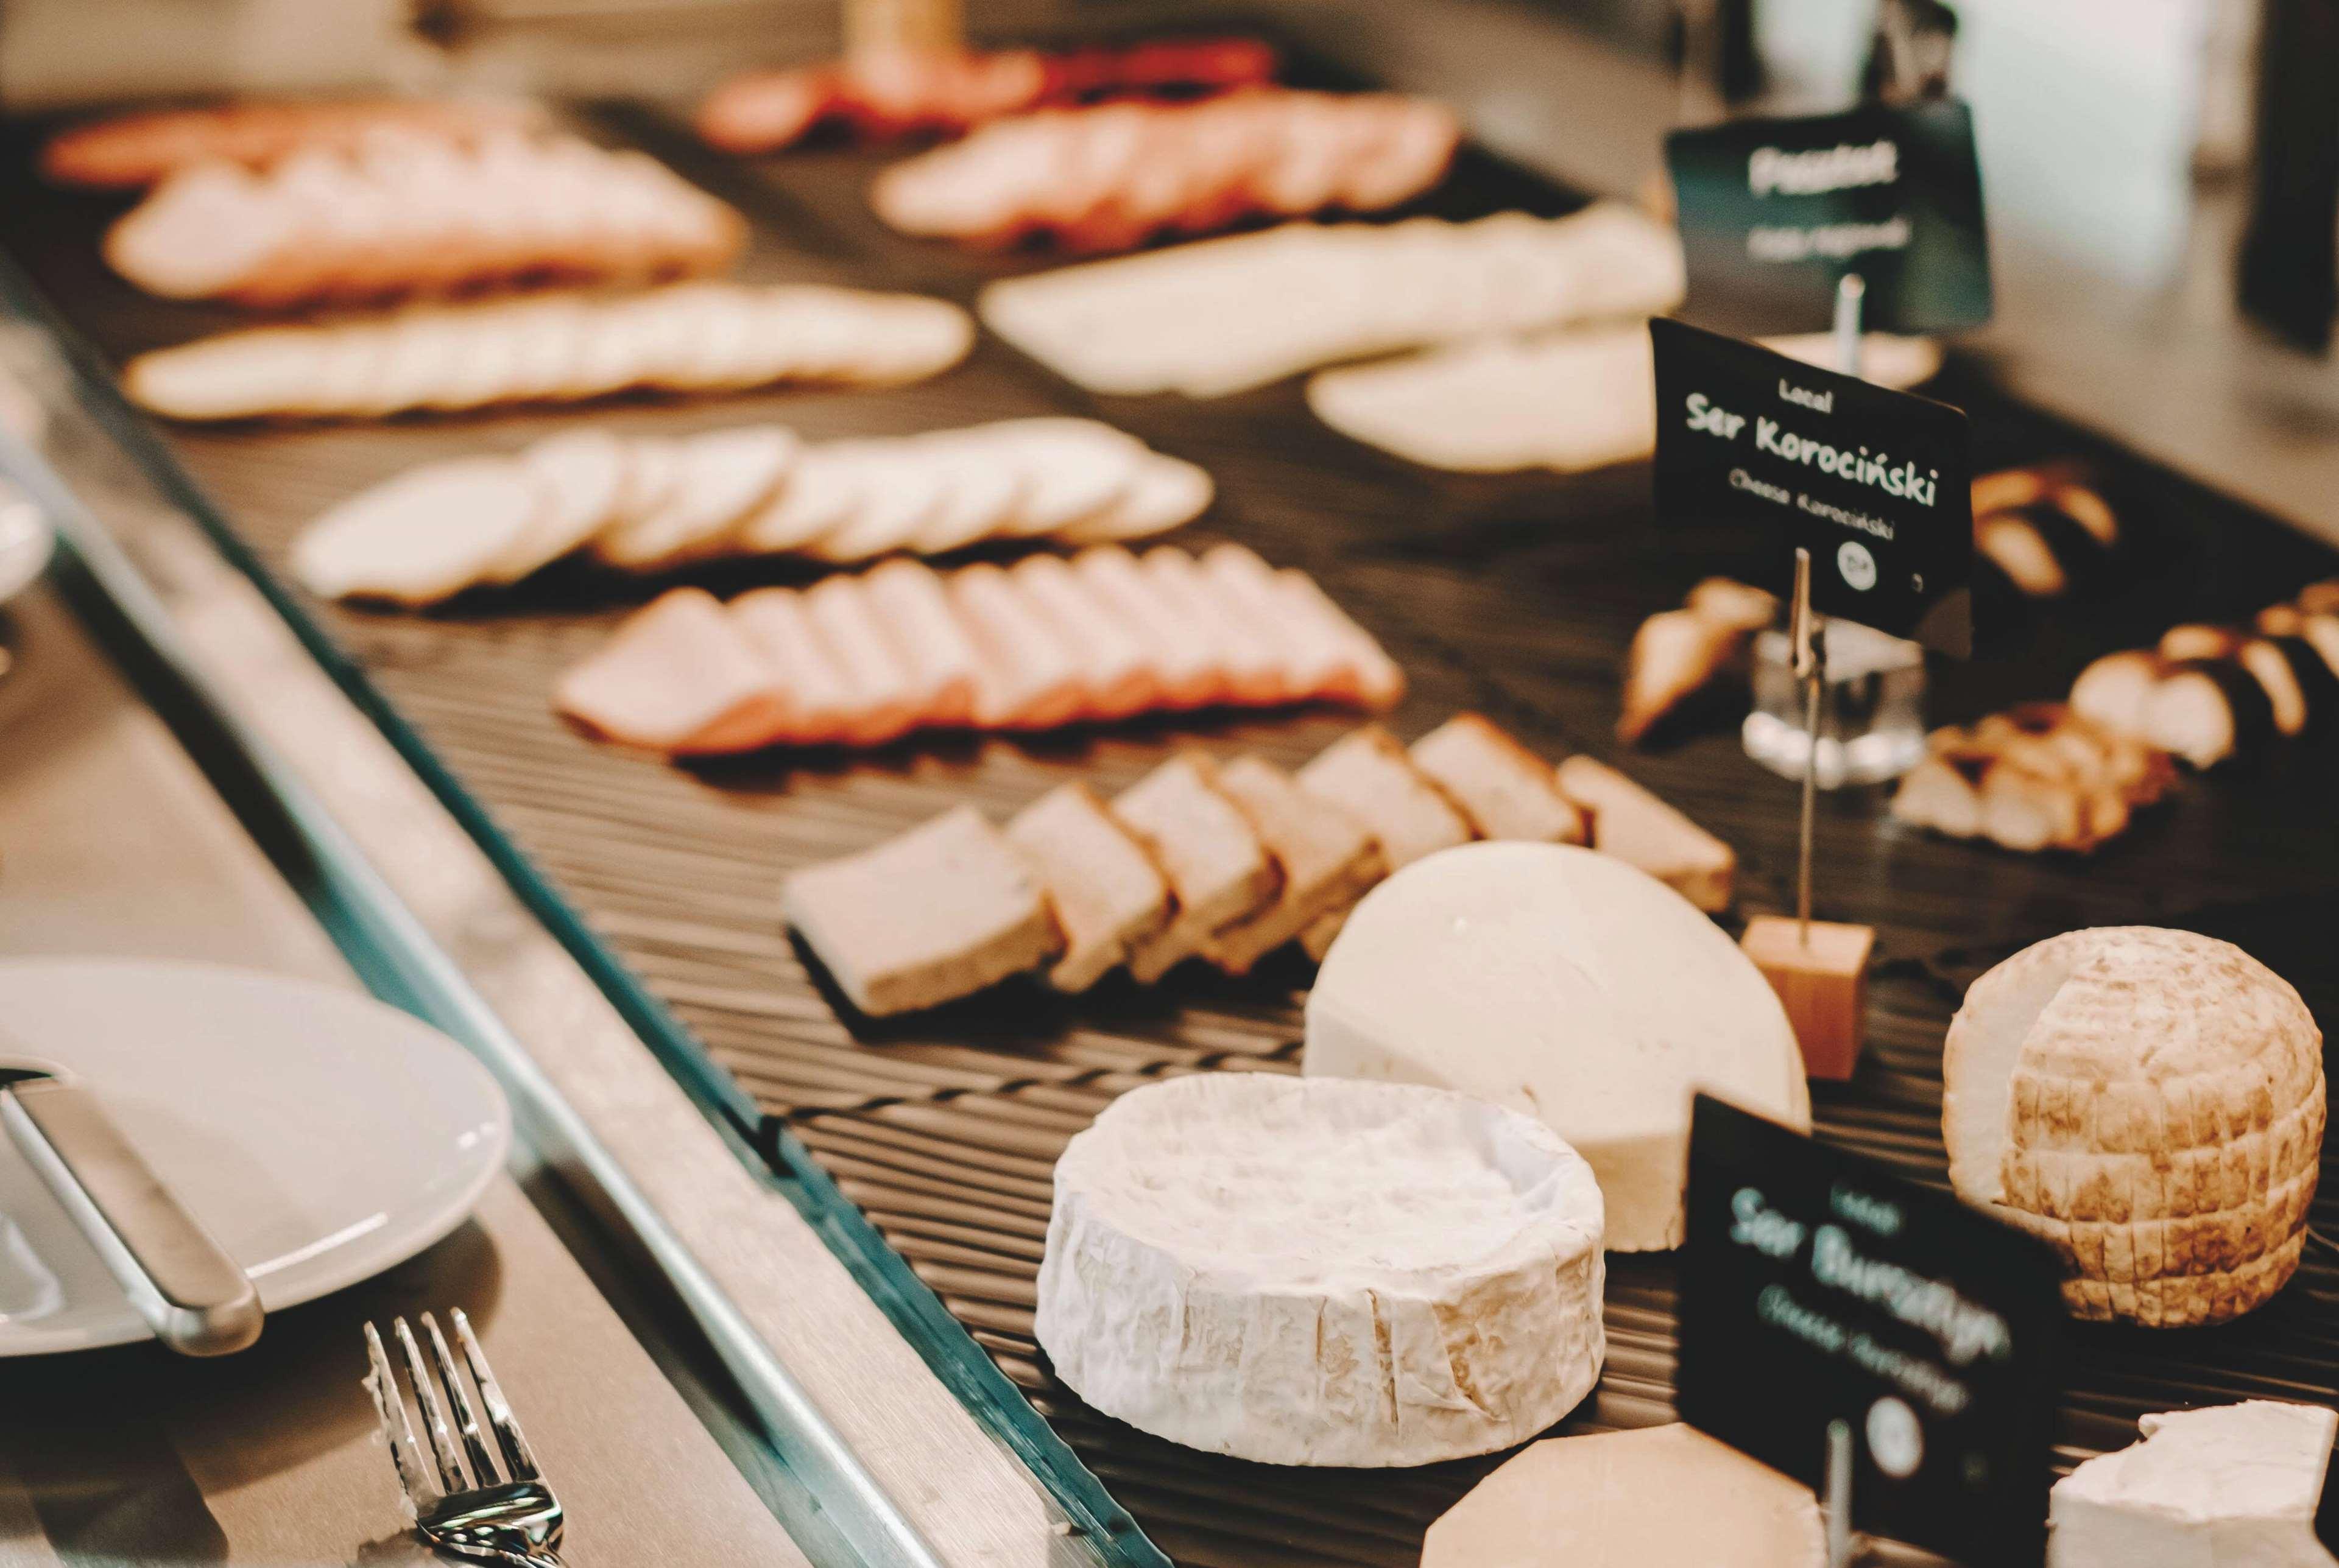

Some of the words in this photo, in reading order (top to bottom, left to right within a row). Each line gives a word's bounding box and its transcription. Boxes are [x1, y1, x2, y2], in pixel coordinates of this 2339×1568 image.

[1779, 378, 1833, 413] Local
[1685, 393, 1746, 440] Ser
[1755, 415, 1939, 507] Korociński
[1729, 468, 1790, 505] Cheese
